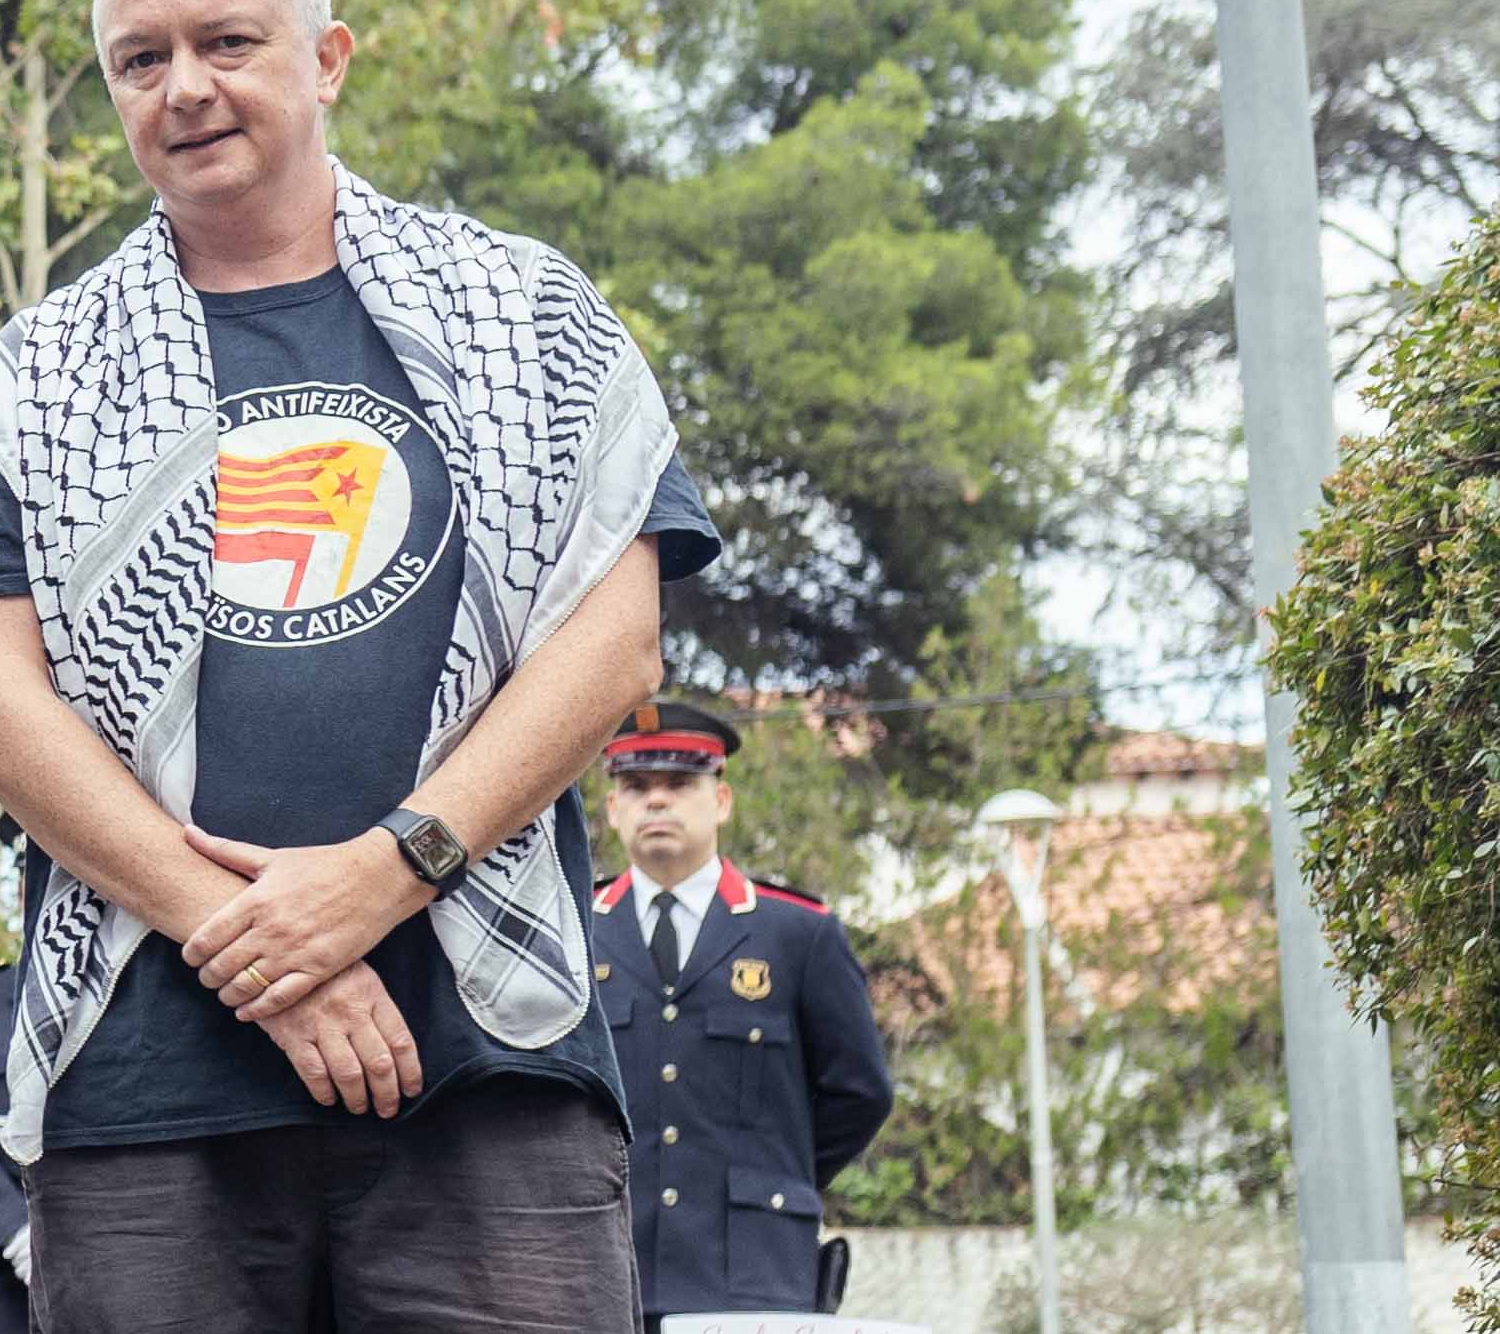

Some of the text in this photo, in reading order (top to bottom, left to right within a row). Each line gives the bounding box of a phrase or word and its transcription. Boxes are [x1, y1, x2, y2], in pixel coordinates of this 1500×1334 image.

[242, 391, 411, 443] ANTIFEIXISTA
[205, 551, 426, 639] ÏSOS CATALANS
